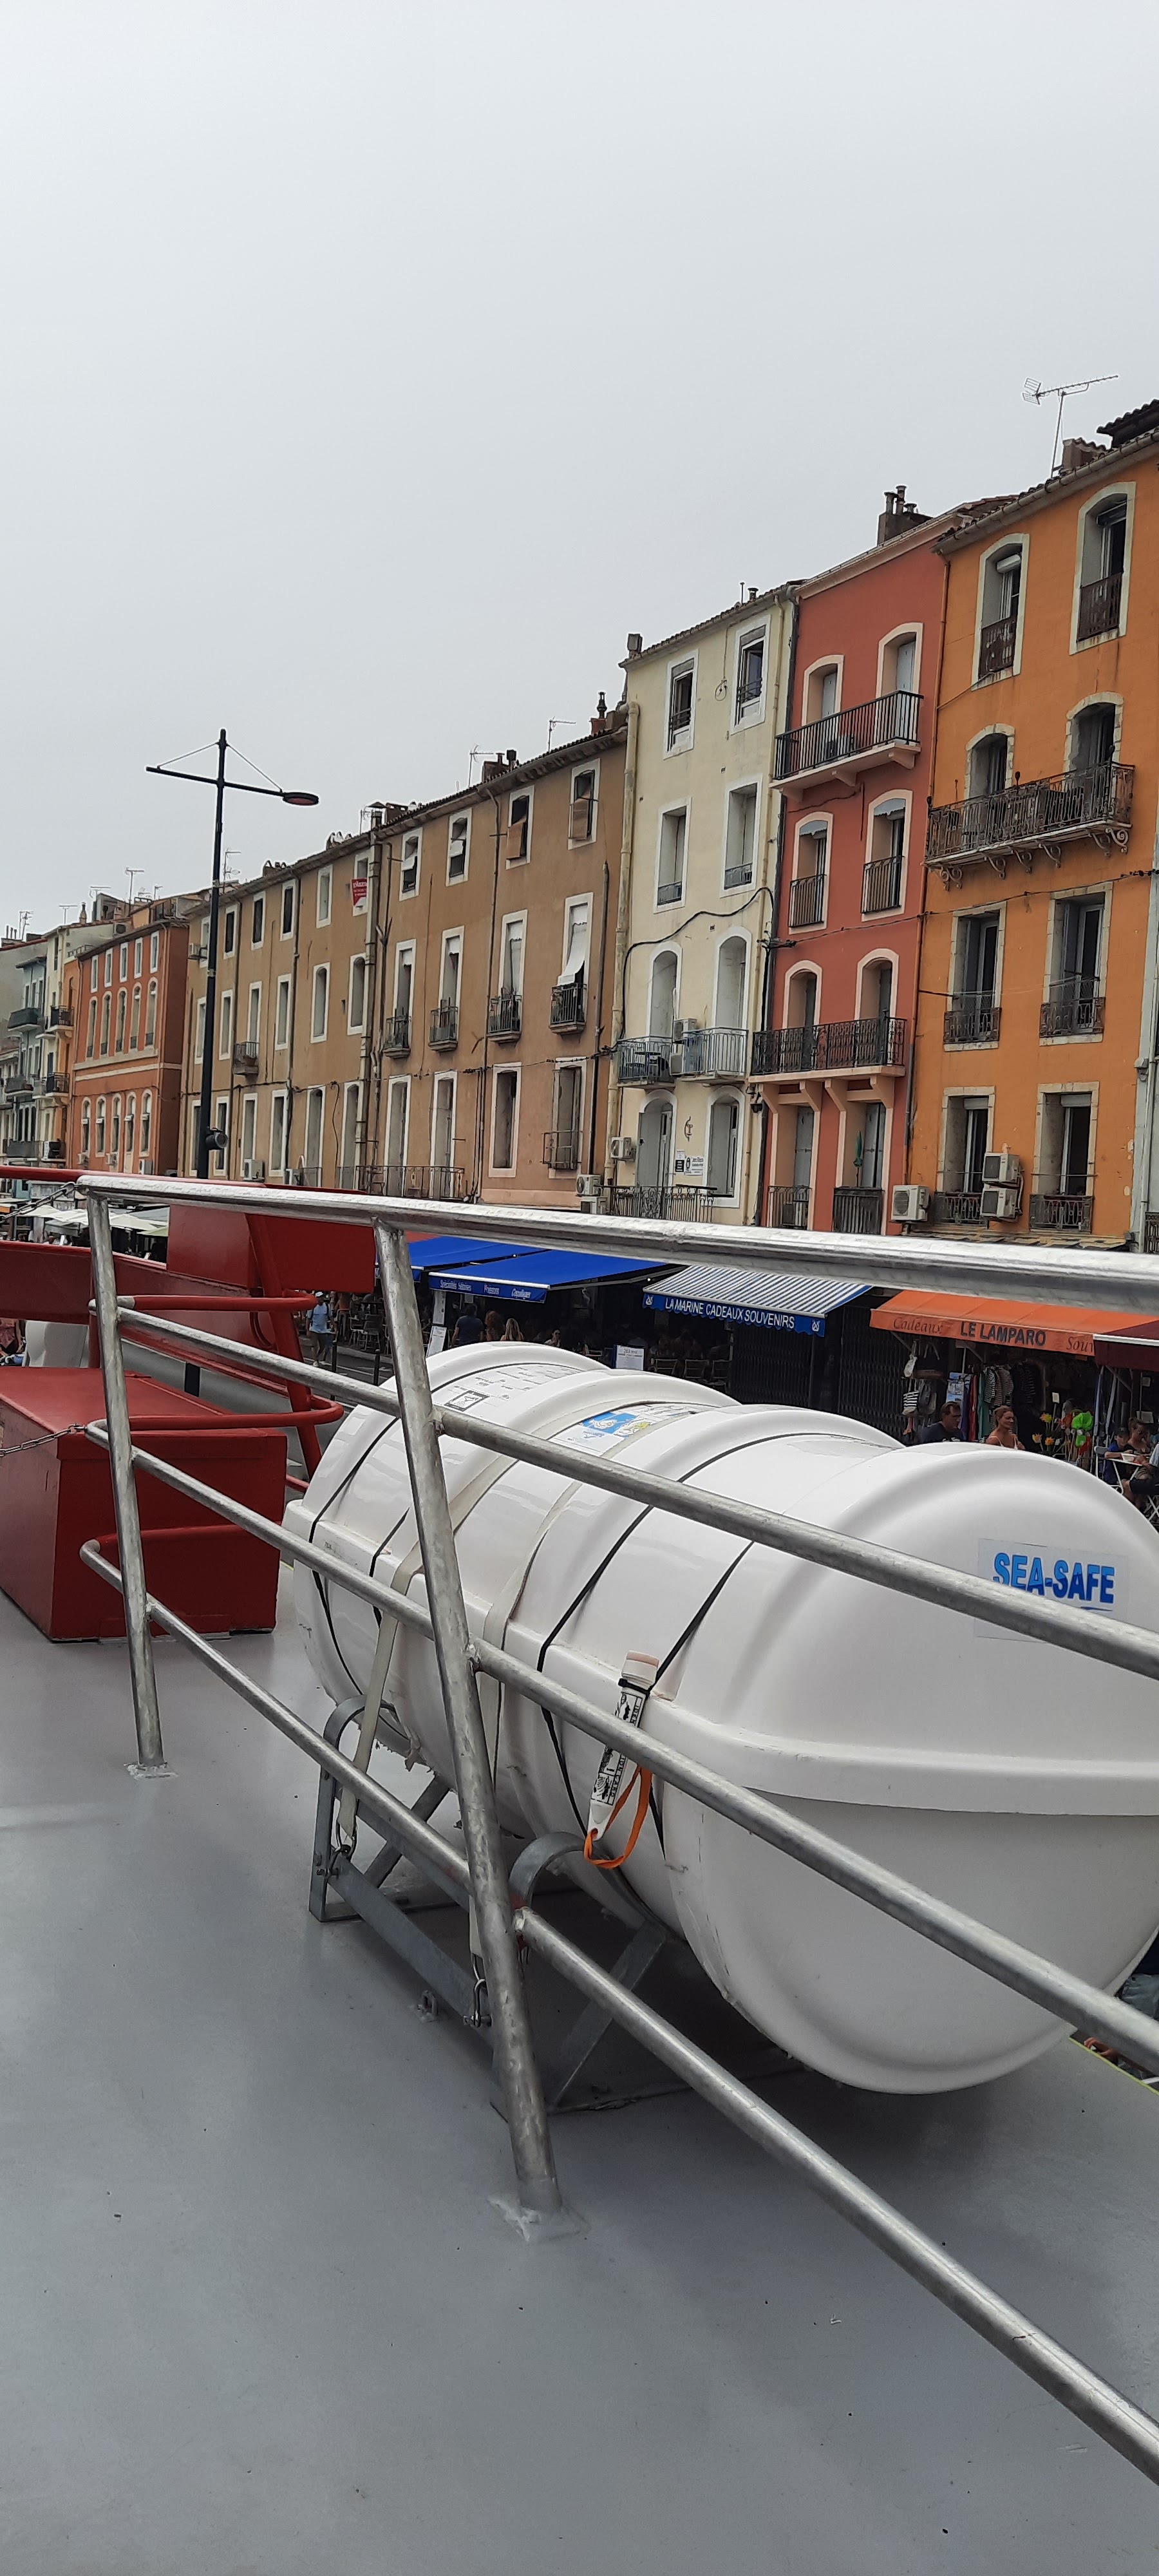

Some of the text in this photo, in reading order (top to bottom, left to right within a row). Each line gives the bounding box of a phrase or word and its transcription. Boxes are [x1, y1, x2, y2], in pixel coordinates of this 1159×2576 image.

[665, 1298, 795, 1329] LA MARINE CADEAUX SOUVENIRS
[893, 1317, 943, 1334] Cadeaux
[960, 1320, 1047, 1347] LE LAMPARO
[992, 1552, 1115, 1604] SEA-SAFE
